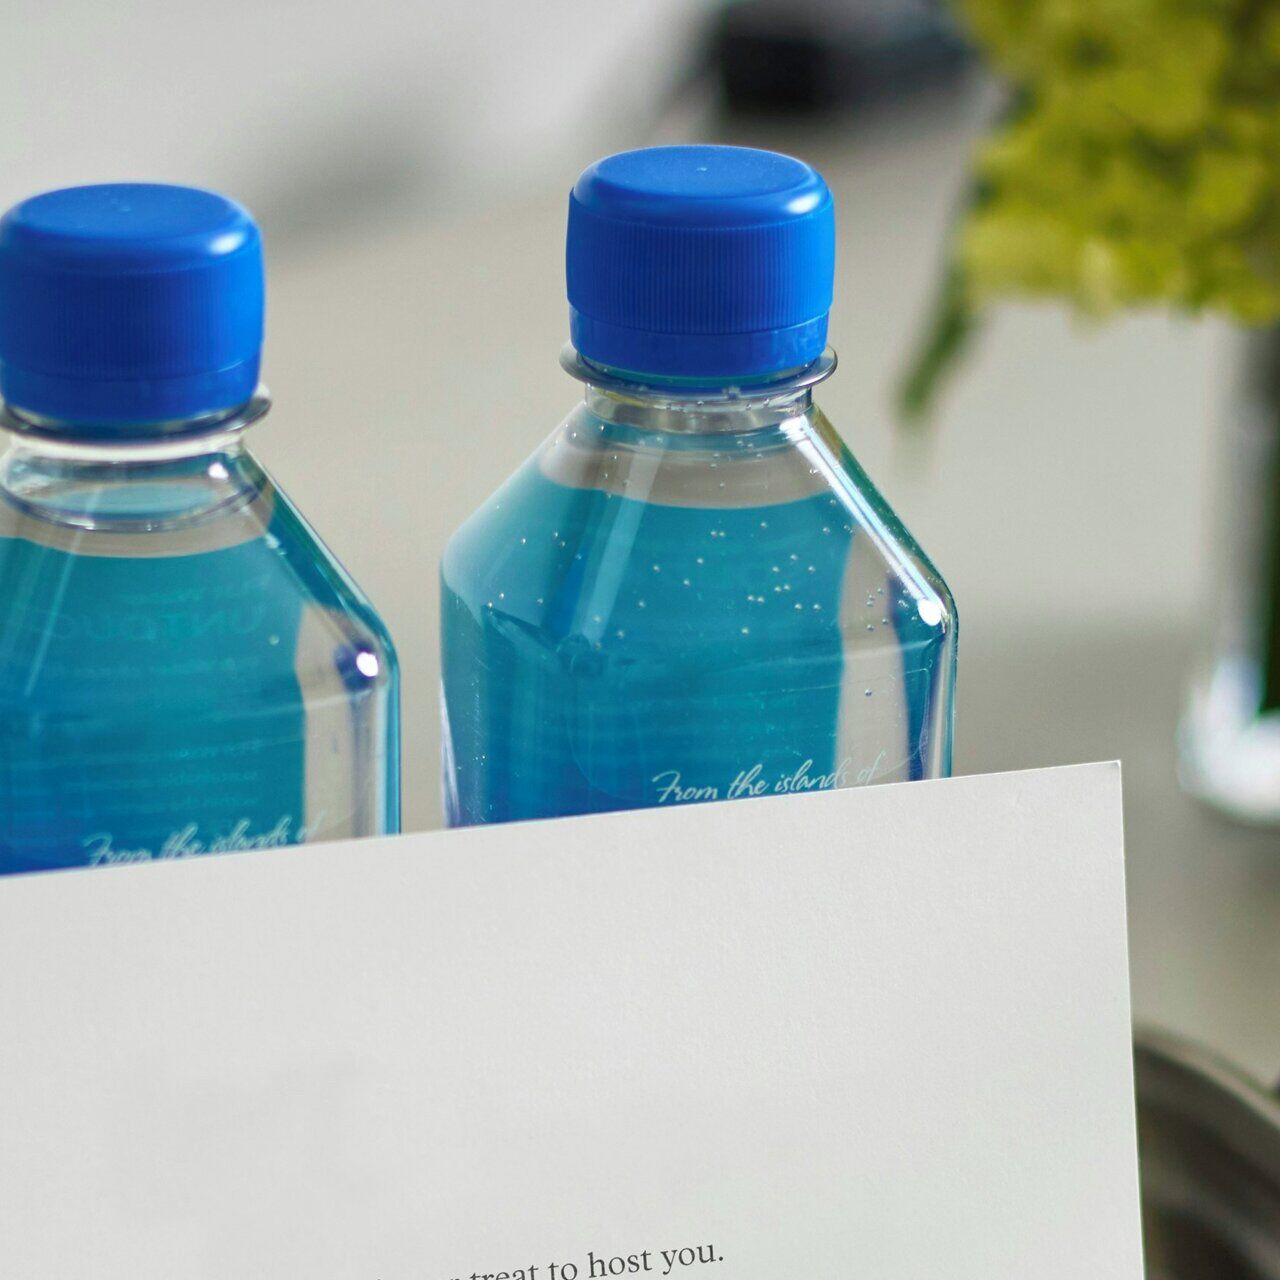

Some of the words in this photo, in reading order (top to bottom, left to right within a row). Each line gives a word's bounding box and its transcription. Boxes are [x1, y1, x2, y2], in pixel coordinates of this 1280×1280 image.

[651, 769, 718, 803] From
[725, 763, 769, 798] the
[773, 757, 850, 793] islands
[856, 748, 887, 786] of
[83, 832, 152, 866] From
[162, 821, 203, 858] the
[587, 1250, 653, 1279] host
[660, 1243, 724, 1276] you.
